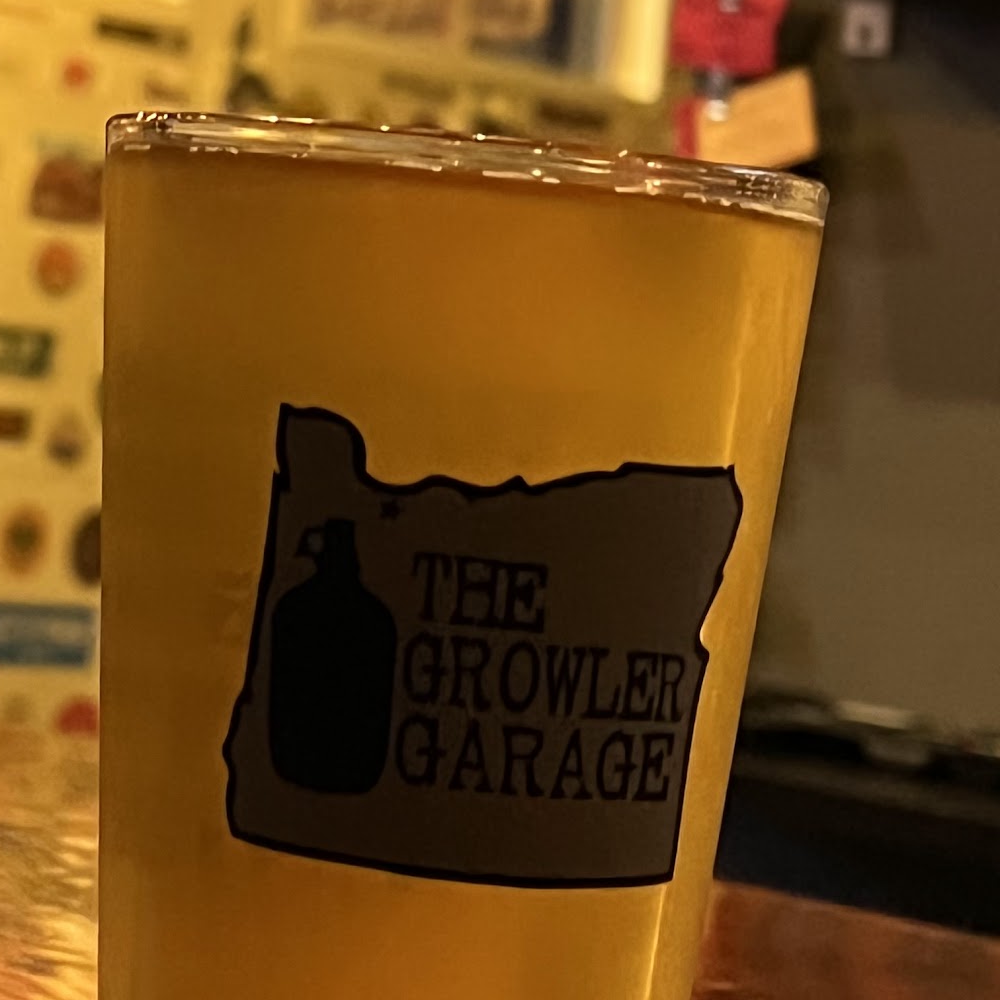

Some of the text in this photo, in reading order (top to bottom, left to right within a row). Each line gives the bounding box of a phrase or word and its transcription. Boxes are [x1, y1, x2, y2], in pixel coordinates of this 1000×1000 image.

[413, 553, 548, 632] THE
[403, 633, 686, 722] GROWLER
[396, 716, 675, 801] GARAGE
